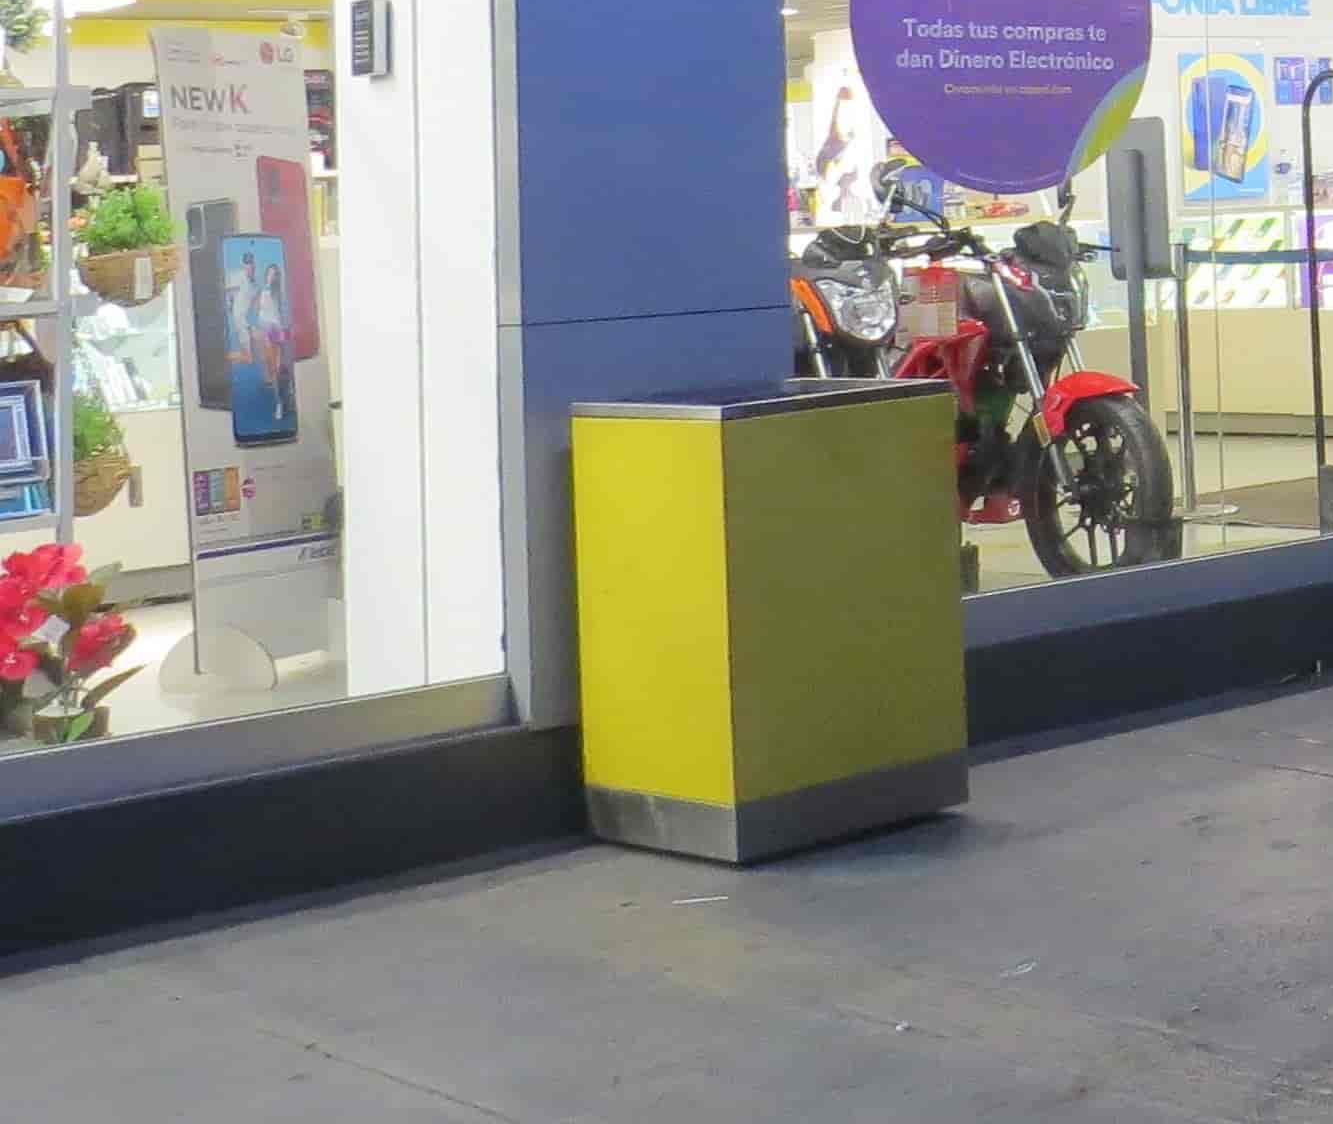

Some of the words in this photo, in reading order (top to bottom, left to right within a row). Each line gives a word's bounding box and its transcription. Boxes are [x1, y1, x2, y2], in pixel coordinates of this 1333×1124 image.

[903, 18, 965, 40] Todas
[970, 21, 998, 39] tus
[1003, 25, 1084, 44] compras
[1088, 25, 1107, 42] te
[896, 49, 933, 69] dan
[939, 49, 1004, 69] Dinero
[1009, 50, 1115, 71] Electrónico
[170, 84, 224, 112] NEW
